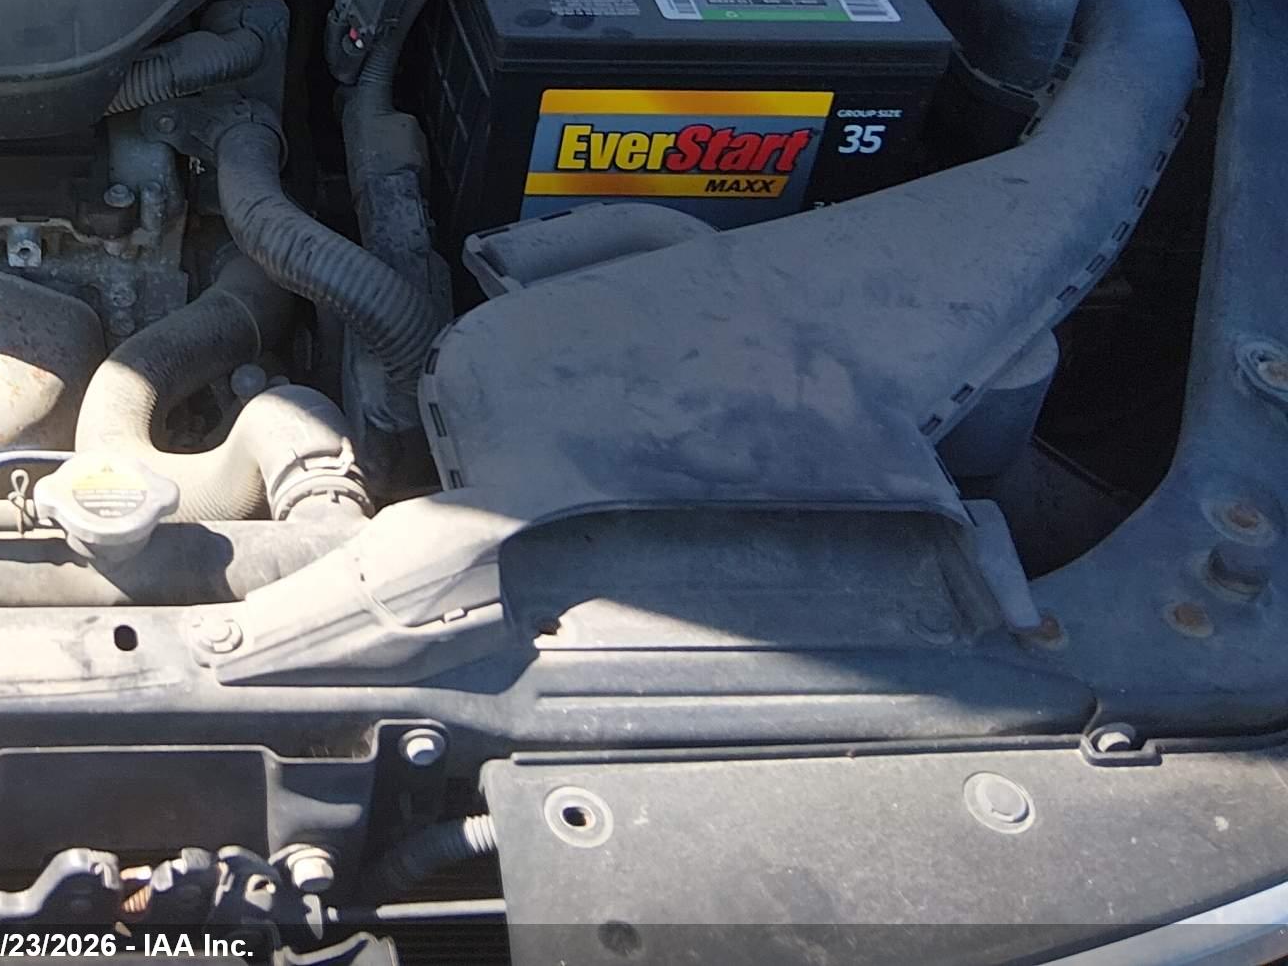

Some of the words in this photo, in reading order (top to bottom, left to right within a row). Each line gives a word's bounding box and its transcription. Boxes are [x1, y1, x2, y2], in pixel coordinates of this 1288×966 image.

[836, 109, 876, 118] GROUP
[877, 109, 903, 118] SIZE
[557, 124, 811, 171] EverStart
[838, 124, 886, 153] 35
[705, 179, 778, 193] MAXX
